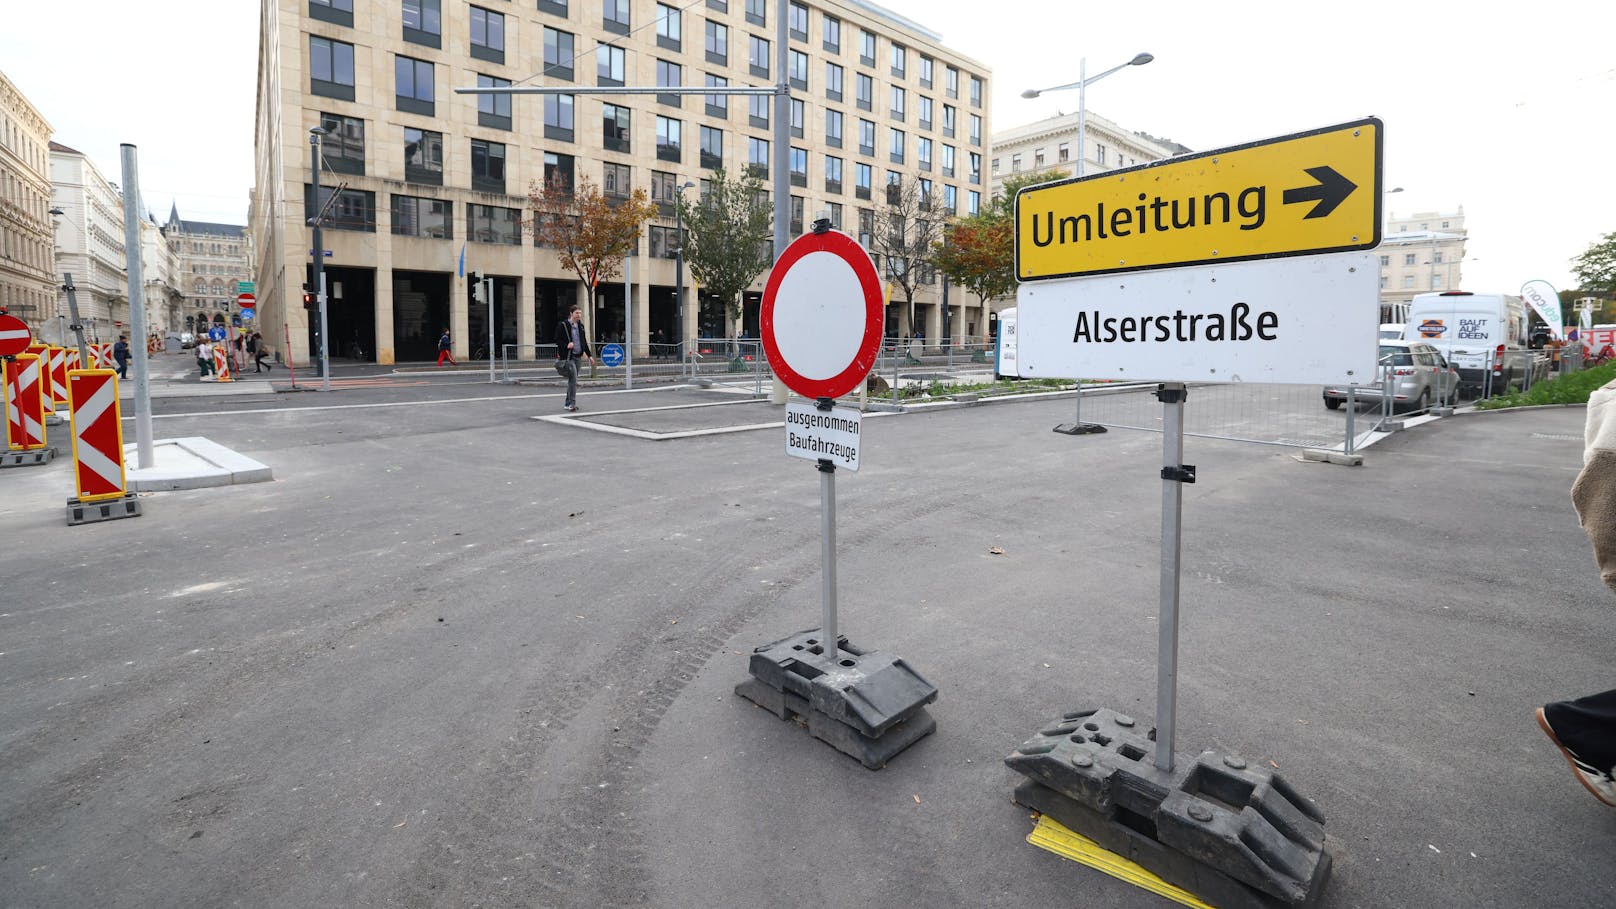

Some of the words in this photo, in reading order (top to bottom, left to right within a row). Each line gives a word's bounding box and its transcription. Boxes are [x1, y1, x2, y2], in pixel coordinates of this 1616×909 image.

[1032, 186, 1266, 248] Umleitung
[1073, 303, 1279, 343] Alserstraße
[1458, 332, 1489, 340] IDEEN
[1581, 332, 1616, 355] RE
[787, 411, 859, 435] ausgenommen
[789, 431, 856, 463] Baufahrzeuge
